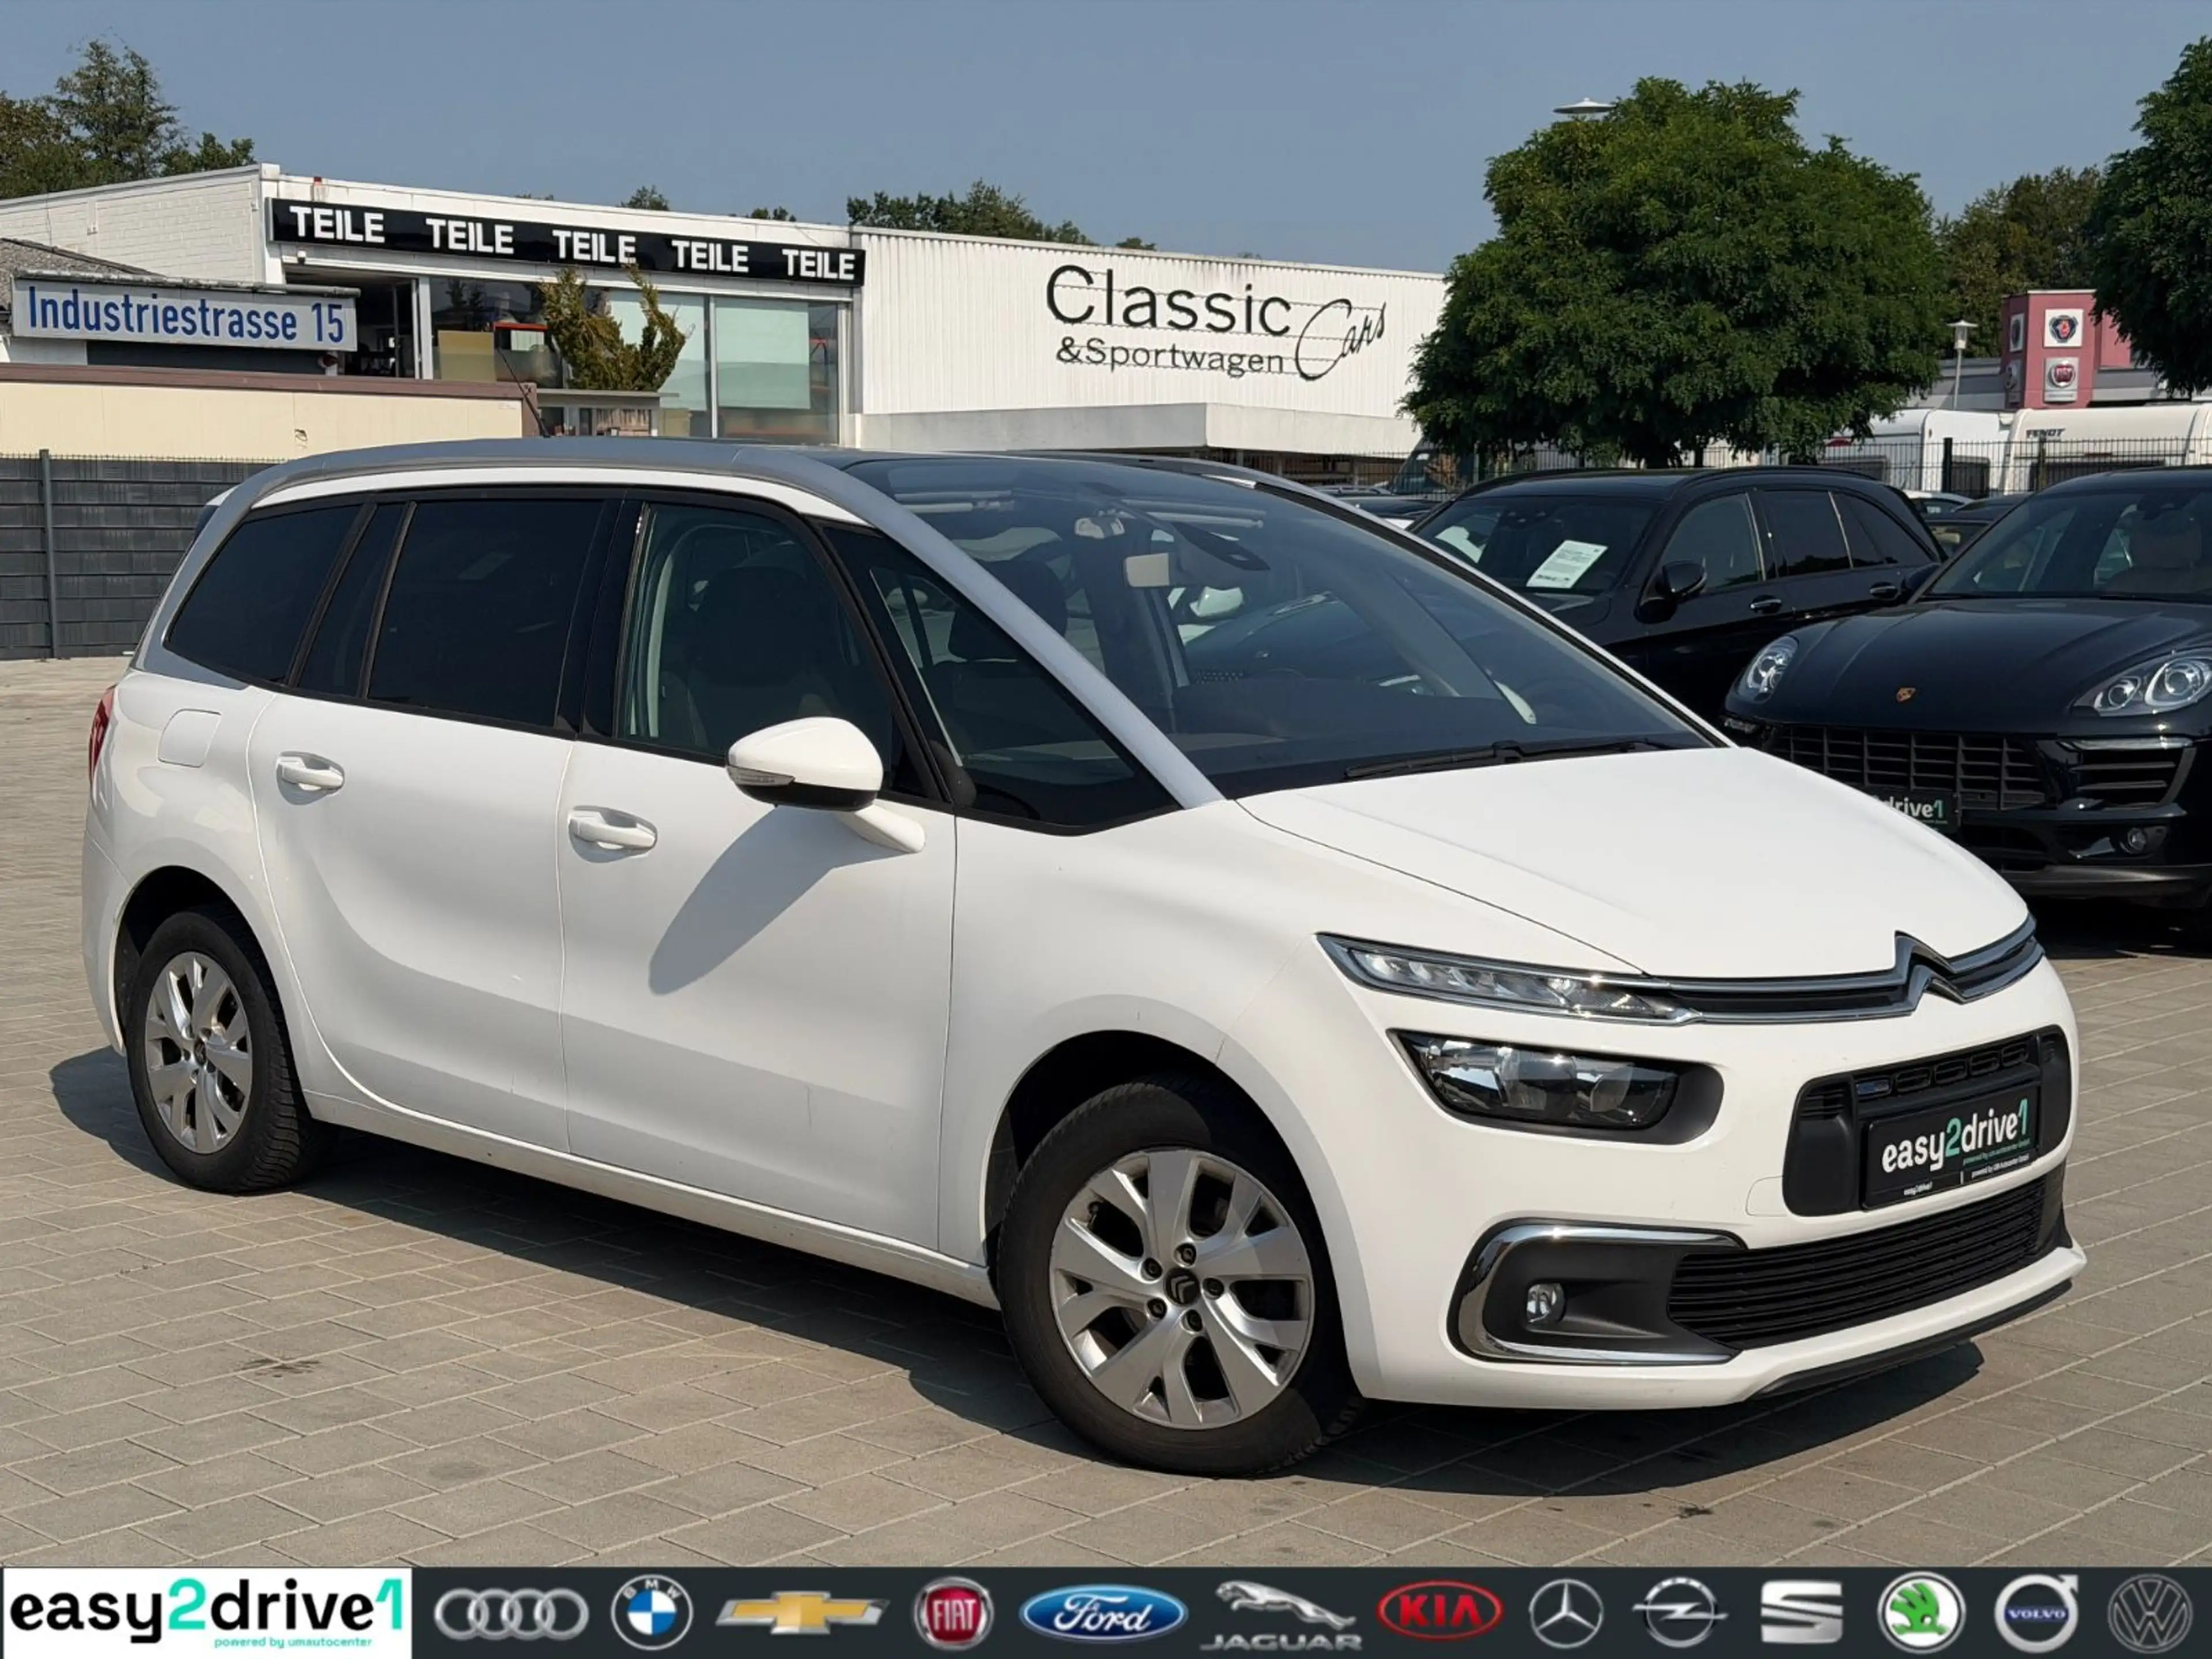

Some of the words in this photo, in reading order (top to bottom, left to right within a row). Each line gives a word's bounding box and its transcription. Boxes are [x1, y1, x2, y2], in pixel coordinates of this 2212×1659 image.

[289, 205, 385, 243] TEILE
[425, 218, 514, 255] TEILE
[552, 229, 637, 264] TEILE
[671, 240, 749, 273] TEILE
[782, 248, 855, 281] TEILE
[29, 286, 297, 341] Industriestrasse
[311, 302, 344, 343] 15
[1046, 264, 1291, 336] Classic
[1294, 297, 1386, 380] Cars
[1881, 1098, 2028, 1173] easy2drive1
